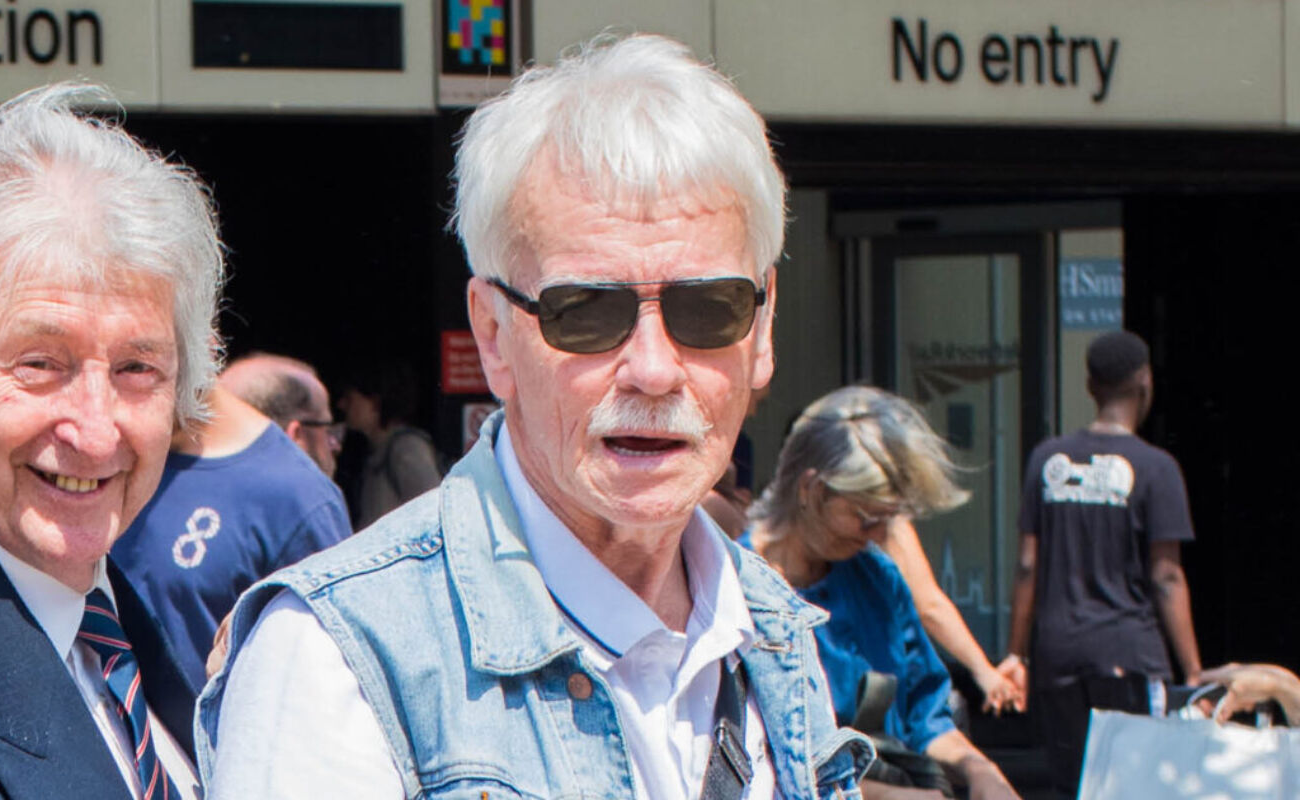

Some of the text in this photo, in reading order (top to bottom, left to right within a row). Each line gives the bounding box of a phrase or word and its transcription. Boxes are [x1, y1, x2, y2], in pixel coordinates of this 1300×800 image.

[891, 17, 1119, 103] No entry
[172, 507, 221, 569] 8
